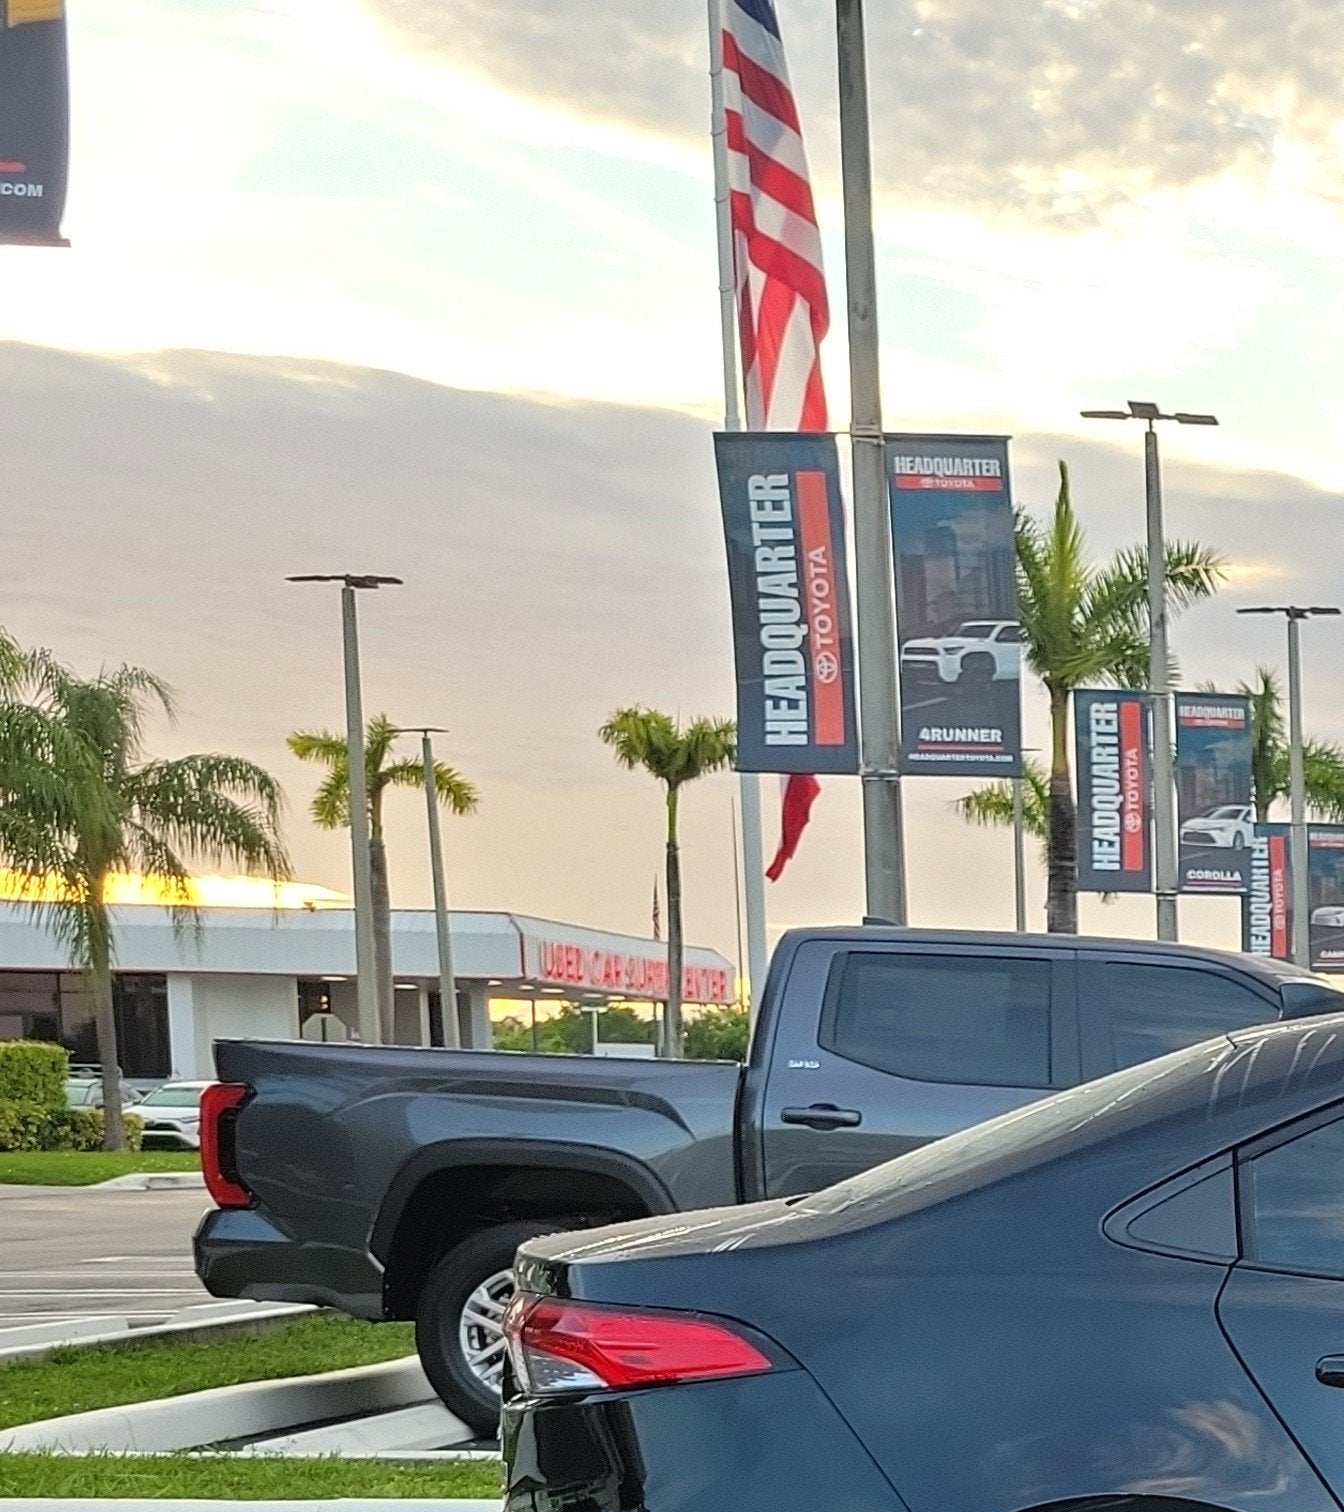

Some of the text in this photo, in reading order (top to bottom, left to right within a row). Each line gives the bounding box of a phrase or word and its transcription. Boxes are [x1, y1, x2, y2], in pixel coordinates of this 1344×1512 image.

[895, 456, 1001, 478] HEADQUARTER
[747, 473, 809, 746] HEADQUARTER
[809, 546, 834, 650] TOYOTA
[918, 727, 1003, 743] 4RUNNER
[1089, 701, 1125, 871] HEADQUARTER
[1124, 748, 1140, 811] TOYOTA
[1186, 869, 1242, 881] COROLLA
[540, 941, 584, 982] USED
[682, 965, 728, 1001] ENTER
